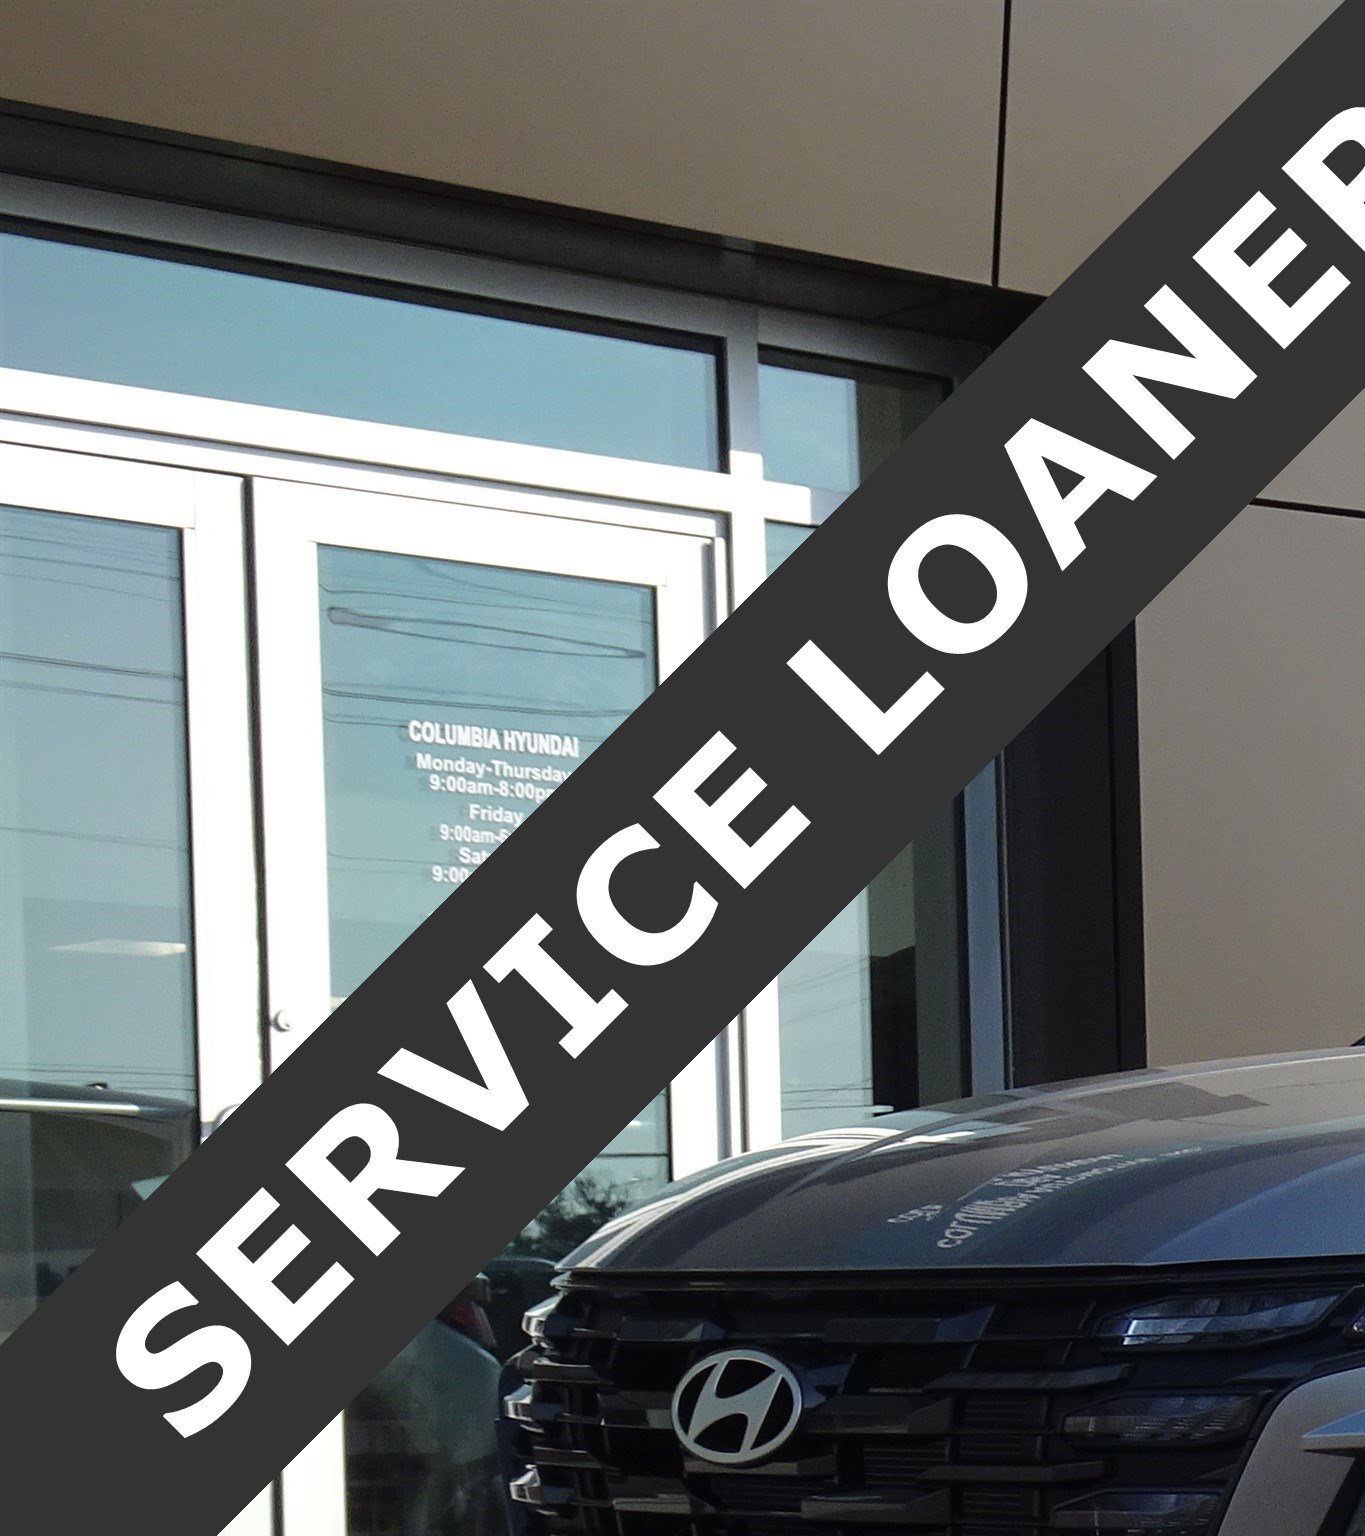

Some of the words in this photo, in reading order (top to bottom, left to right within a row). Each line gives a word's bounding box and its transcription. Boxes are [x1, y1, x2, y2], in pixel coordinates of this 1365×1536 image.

[408, 719, 501, 749] COLUMBIA
[503, 729, 580, 758] HYUNDAI
[415, 752, 573, 782] Monday-Thursday
[468, 803, 524, 827] Friday
[458, 847, 490, 864] Sat
[431, 865, 474, 884] 9:00
